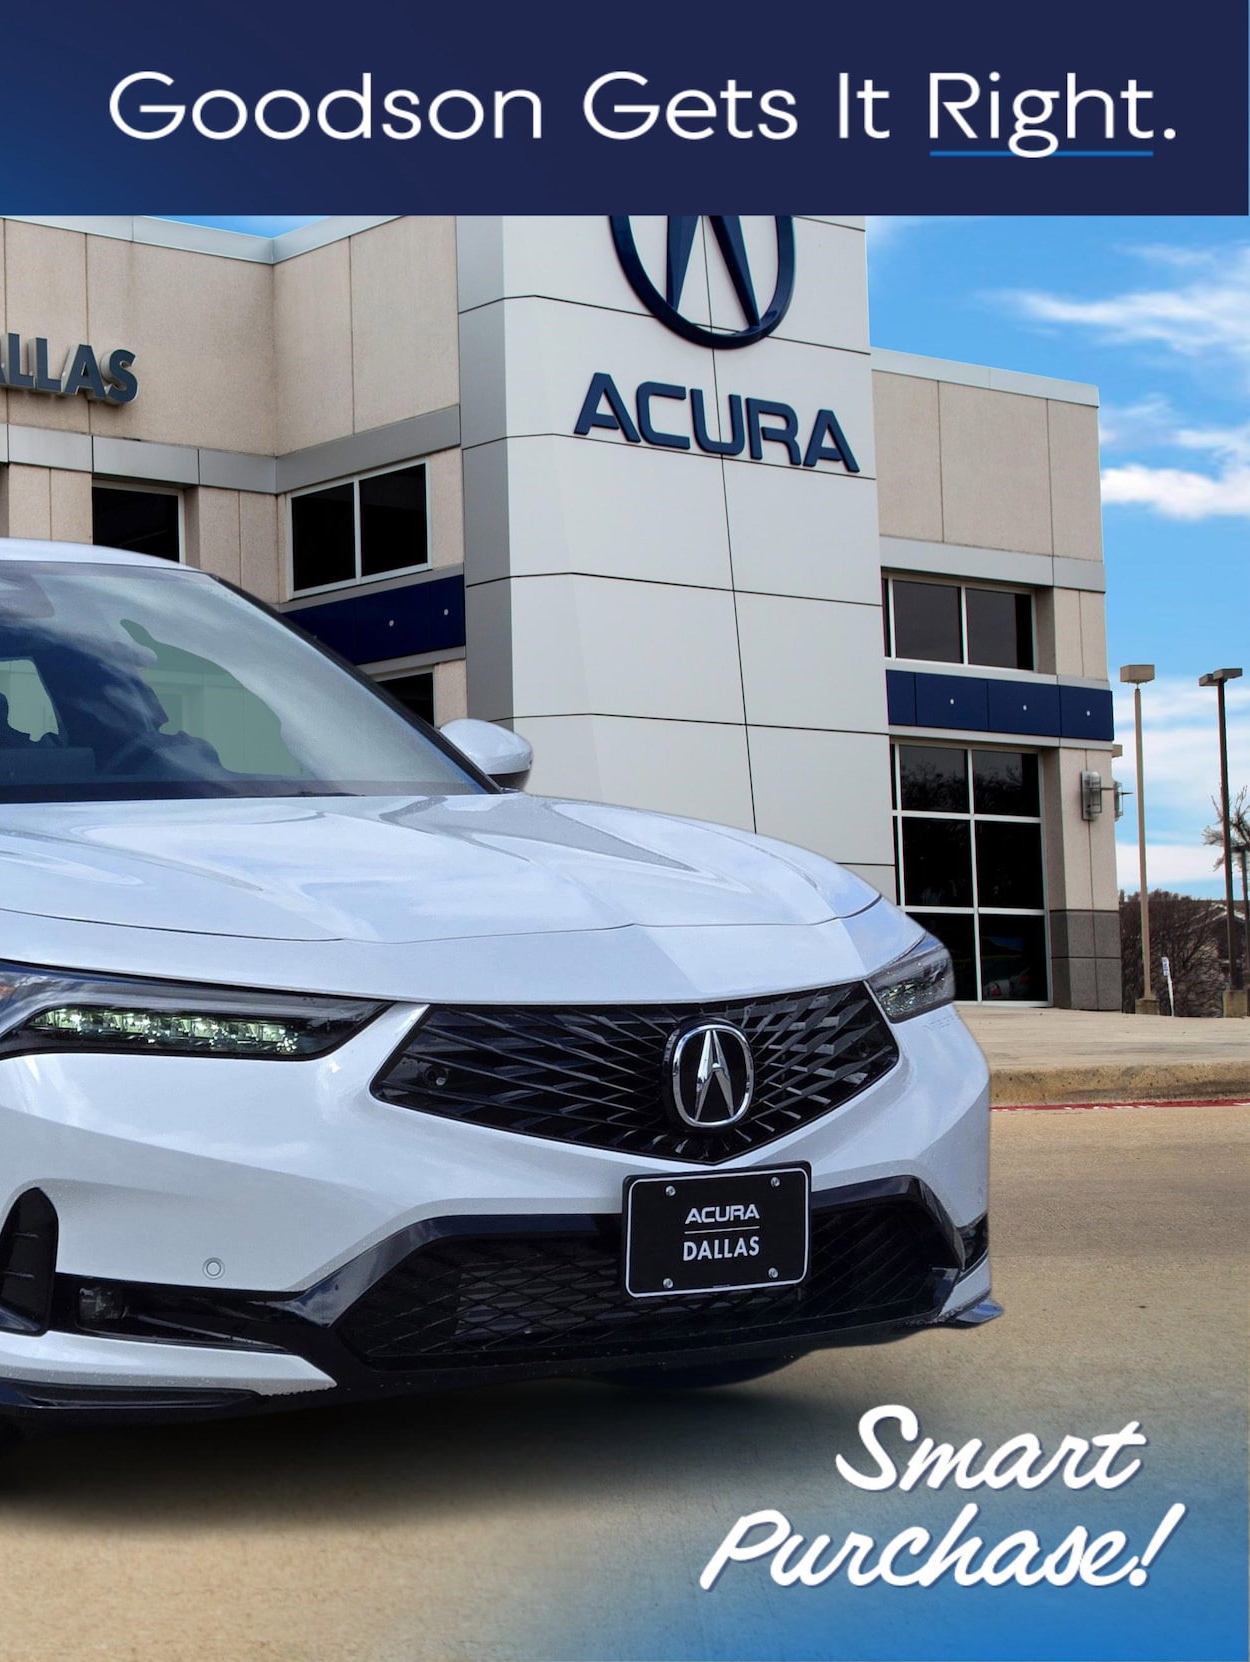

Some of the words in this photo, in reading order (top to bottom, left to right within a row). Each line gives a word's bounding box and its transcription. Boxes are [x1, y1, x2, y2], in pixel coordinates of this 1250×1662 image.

[573, 372, 860, 473] ACURA
[684, 1203, 760, 1225] ACURA
[683, 1236, 760, 1262] DALLAS
